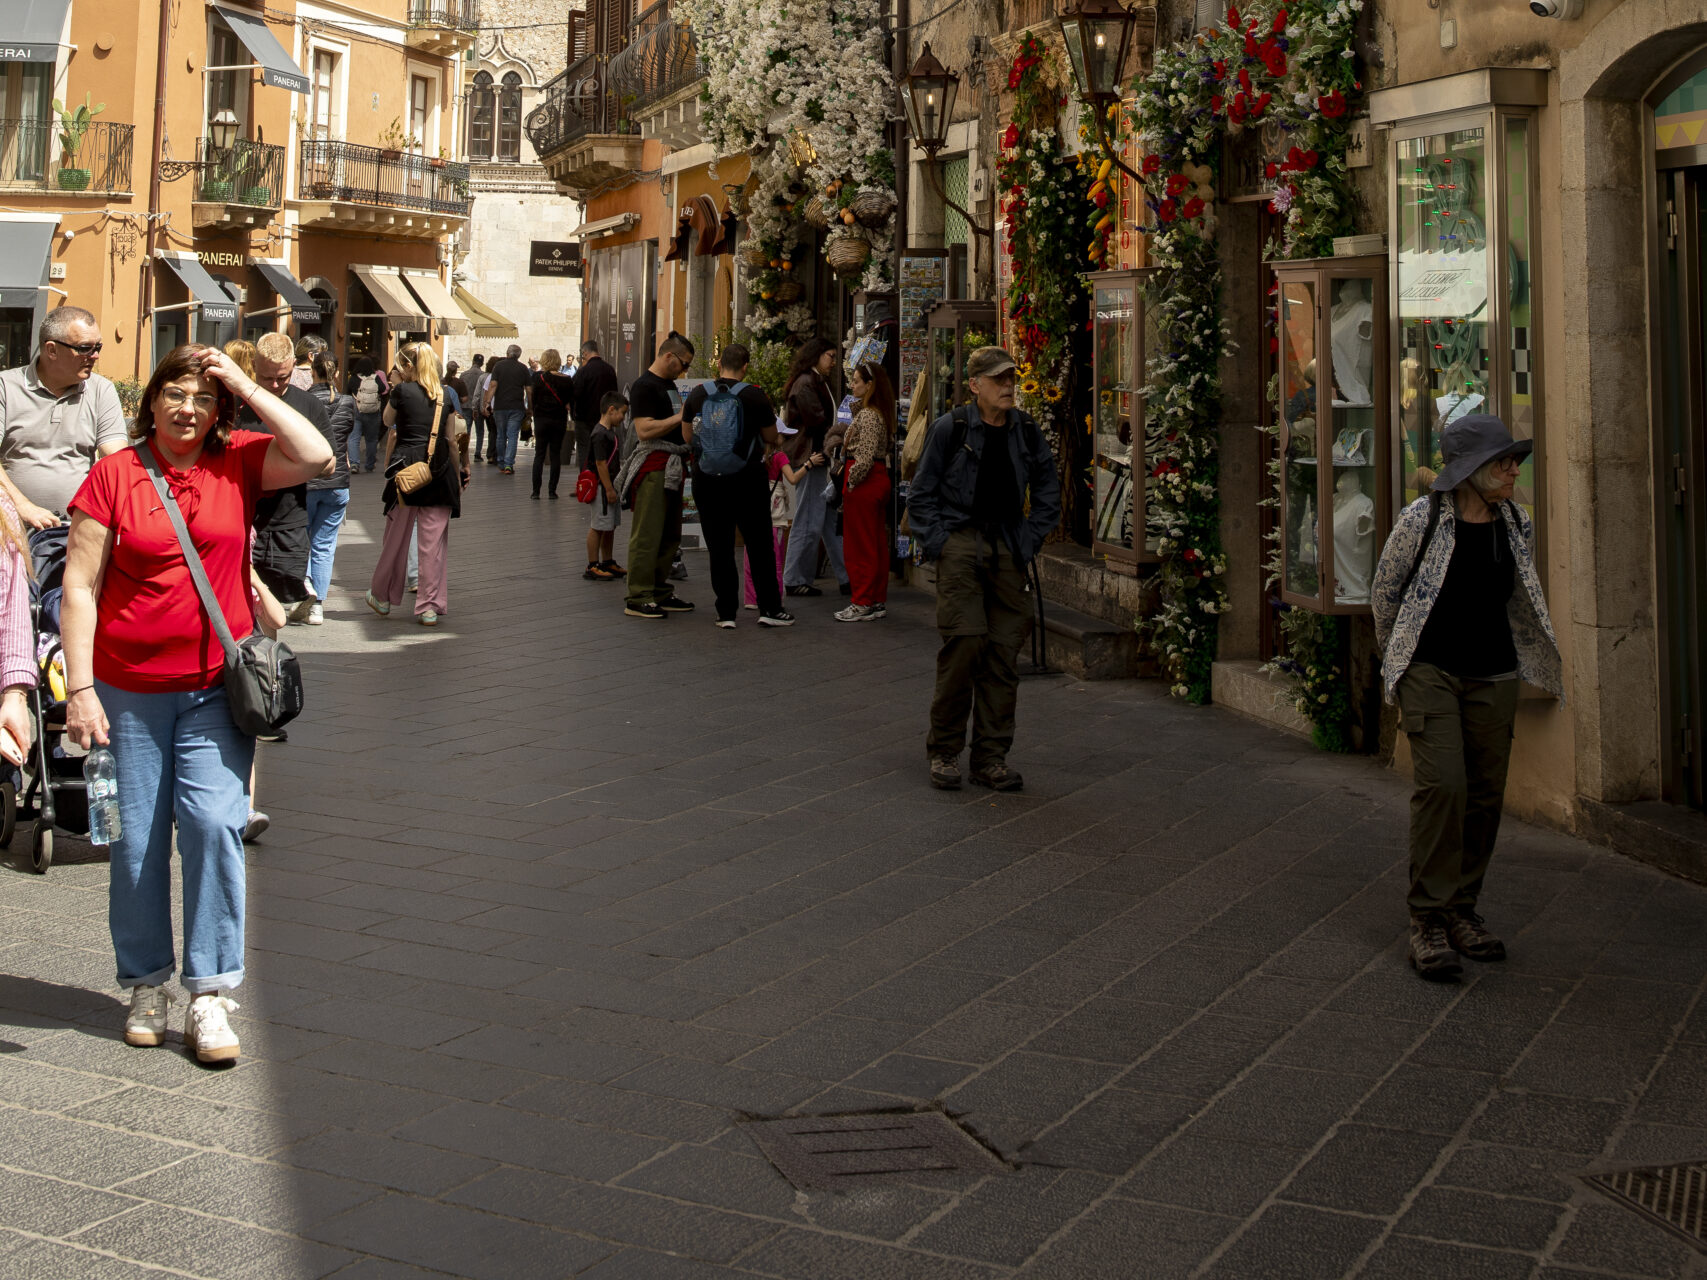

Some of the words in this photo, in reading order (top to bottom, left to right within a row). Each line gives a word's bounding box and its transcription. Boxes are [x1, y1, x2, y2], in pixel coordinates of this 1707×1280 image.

[273, 74, 301, 89] PANERAI
[197, 252, 243, 267] PANERAI
[535, 258, 552, 266] PATEK
[552, 259, 578, 267] PHILIPPE
[205, 308, 235, 318] PANERAI
[292, 311, 319, 320] PANERAI
